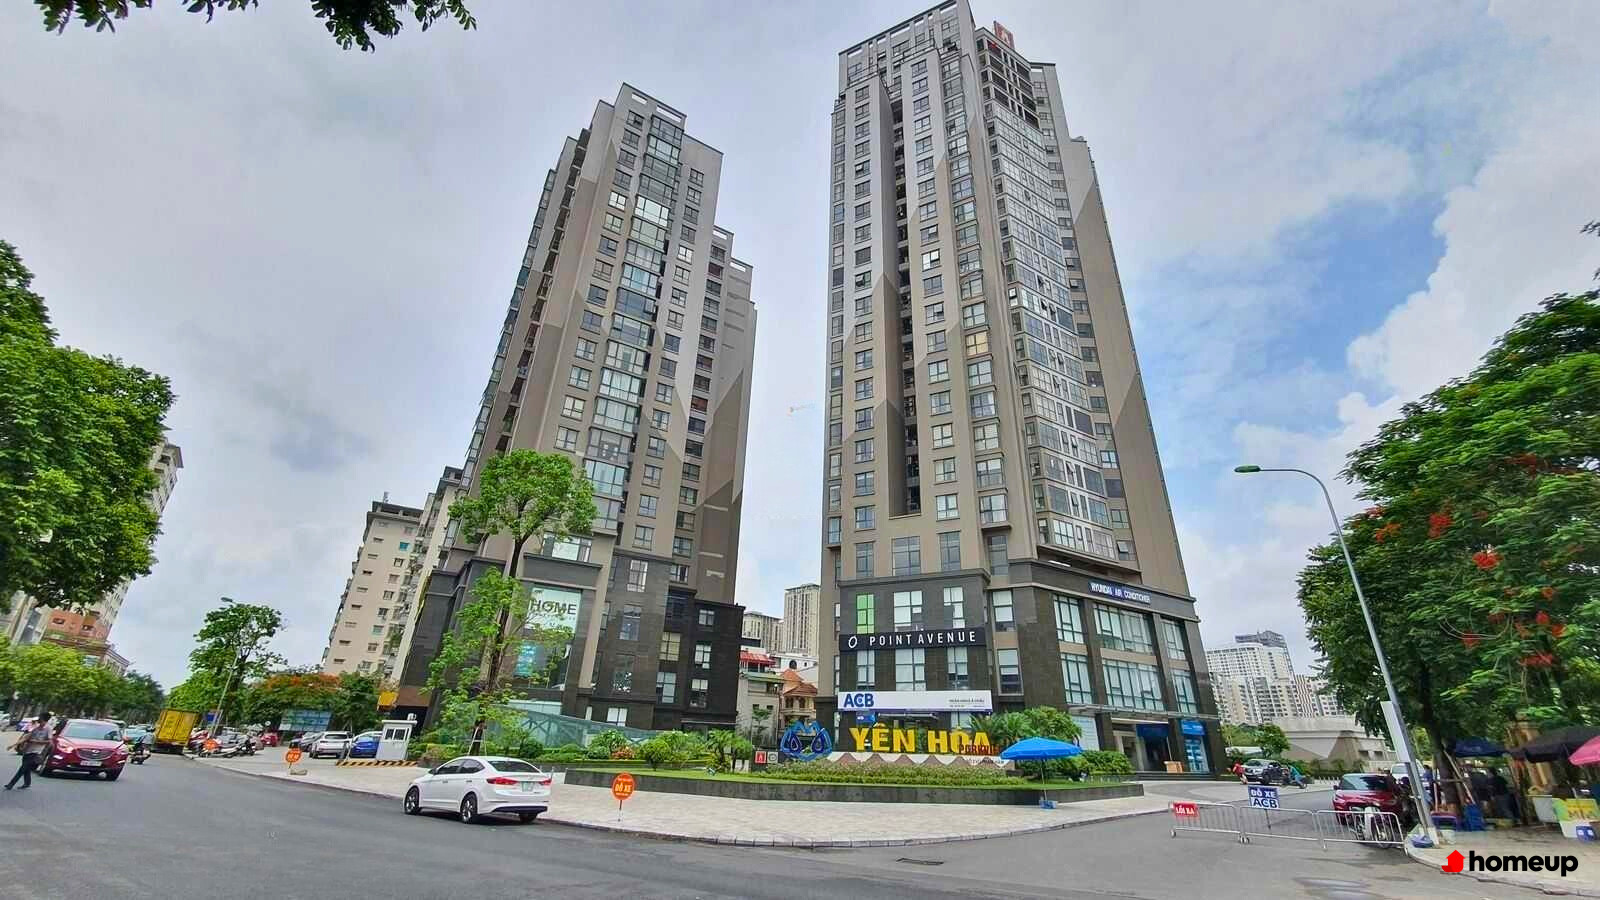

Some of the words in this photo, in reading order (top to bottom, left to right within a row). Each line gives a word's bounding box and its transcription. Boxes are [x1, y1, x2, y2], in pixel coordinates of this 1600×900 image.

[531, 600, 577, 615] HOME
[870, 634, 912, 646] POINT
[918, 631, 976, 644] AVENUE
[843, 693, 874, 708] ACB
[849, 722, 916, 753] YÊN
[1253, 798, 1277, 808] ACB
